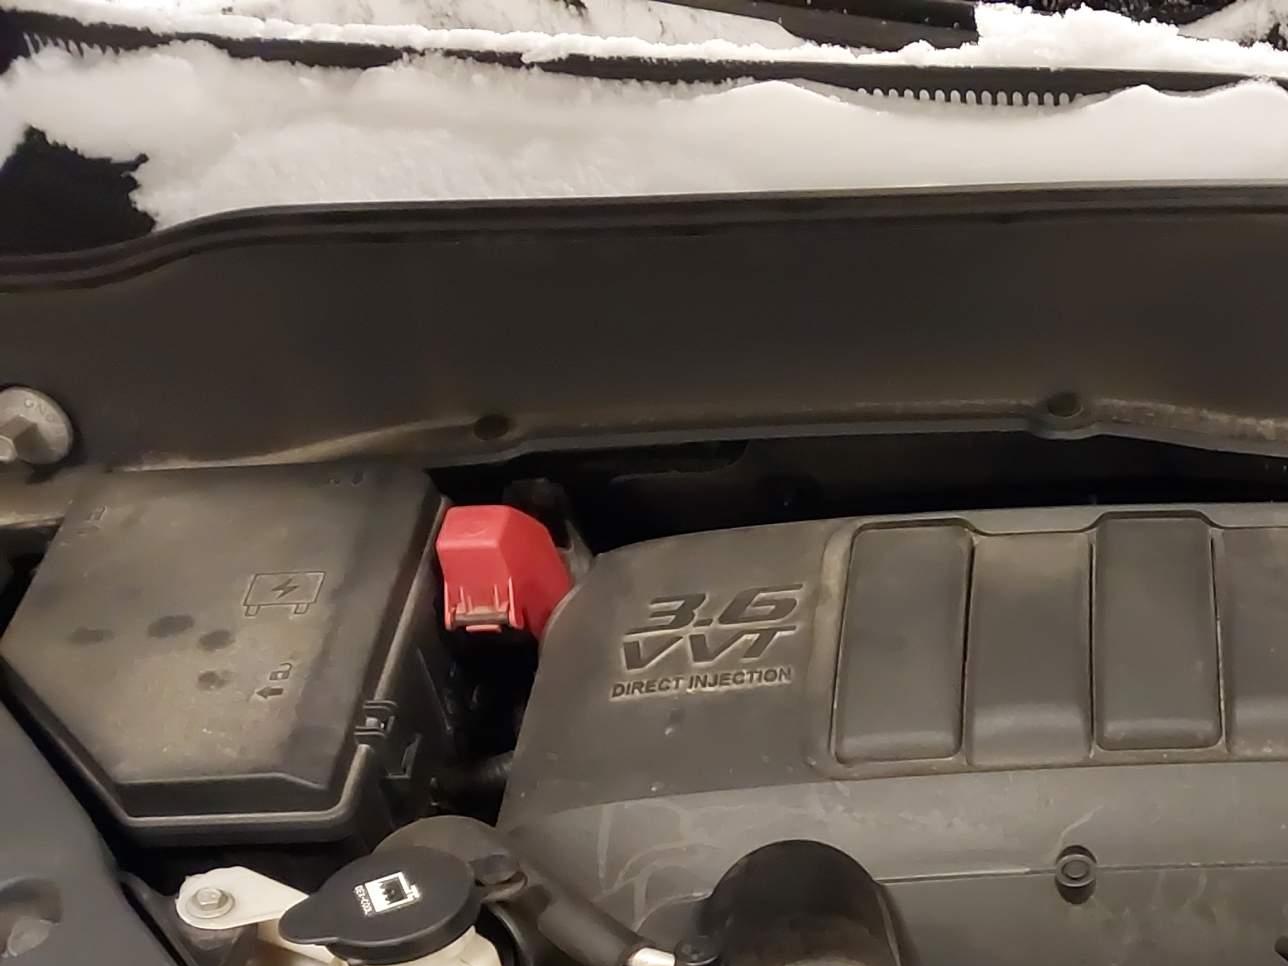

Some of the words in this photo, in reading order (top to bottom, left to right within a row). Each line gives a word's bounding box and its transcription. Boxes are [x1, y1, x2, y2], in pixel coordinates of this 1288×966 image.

[625, 583, 803, 637] 3.6
[622, 625, 797, 671] VVT
[611, 676, 683, 699] DIRECT
[688, 667, 792, 691] INJECTION
